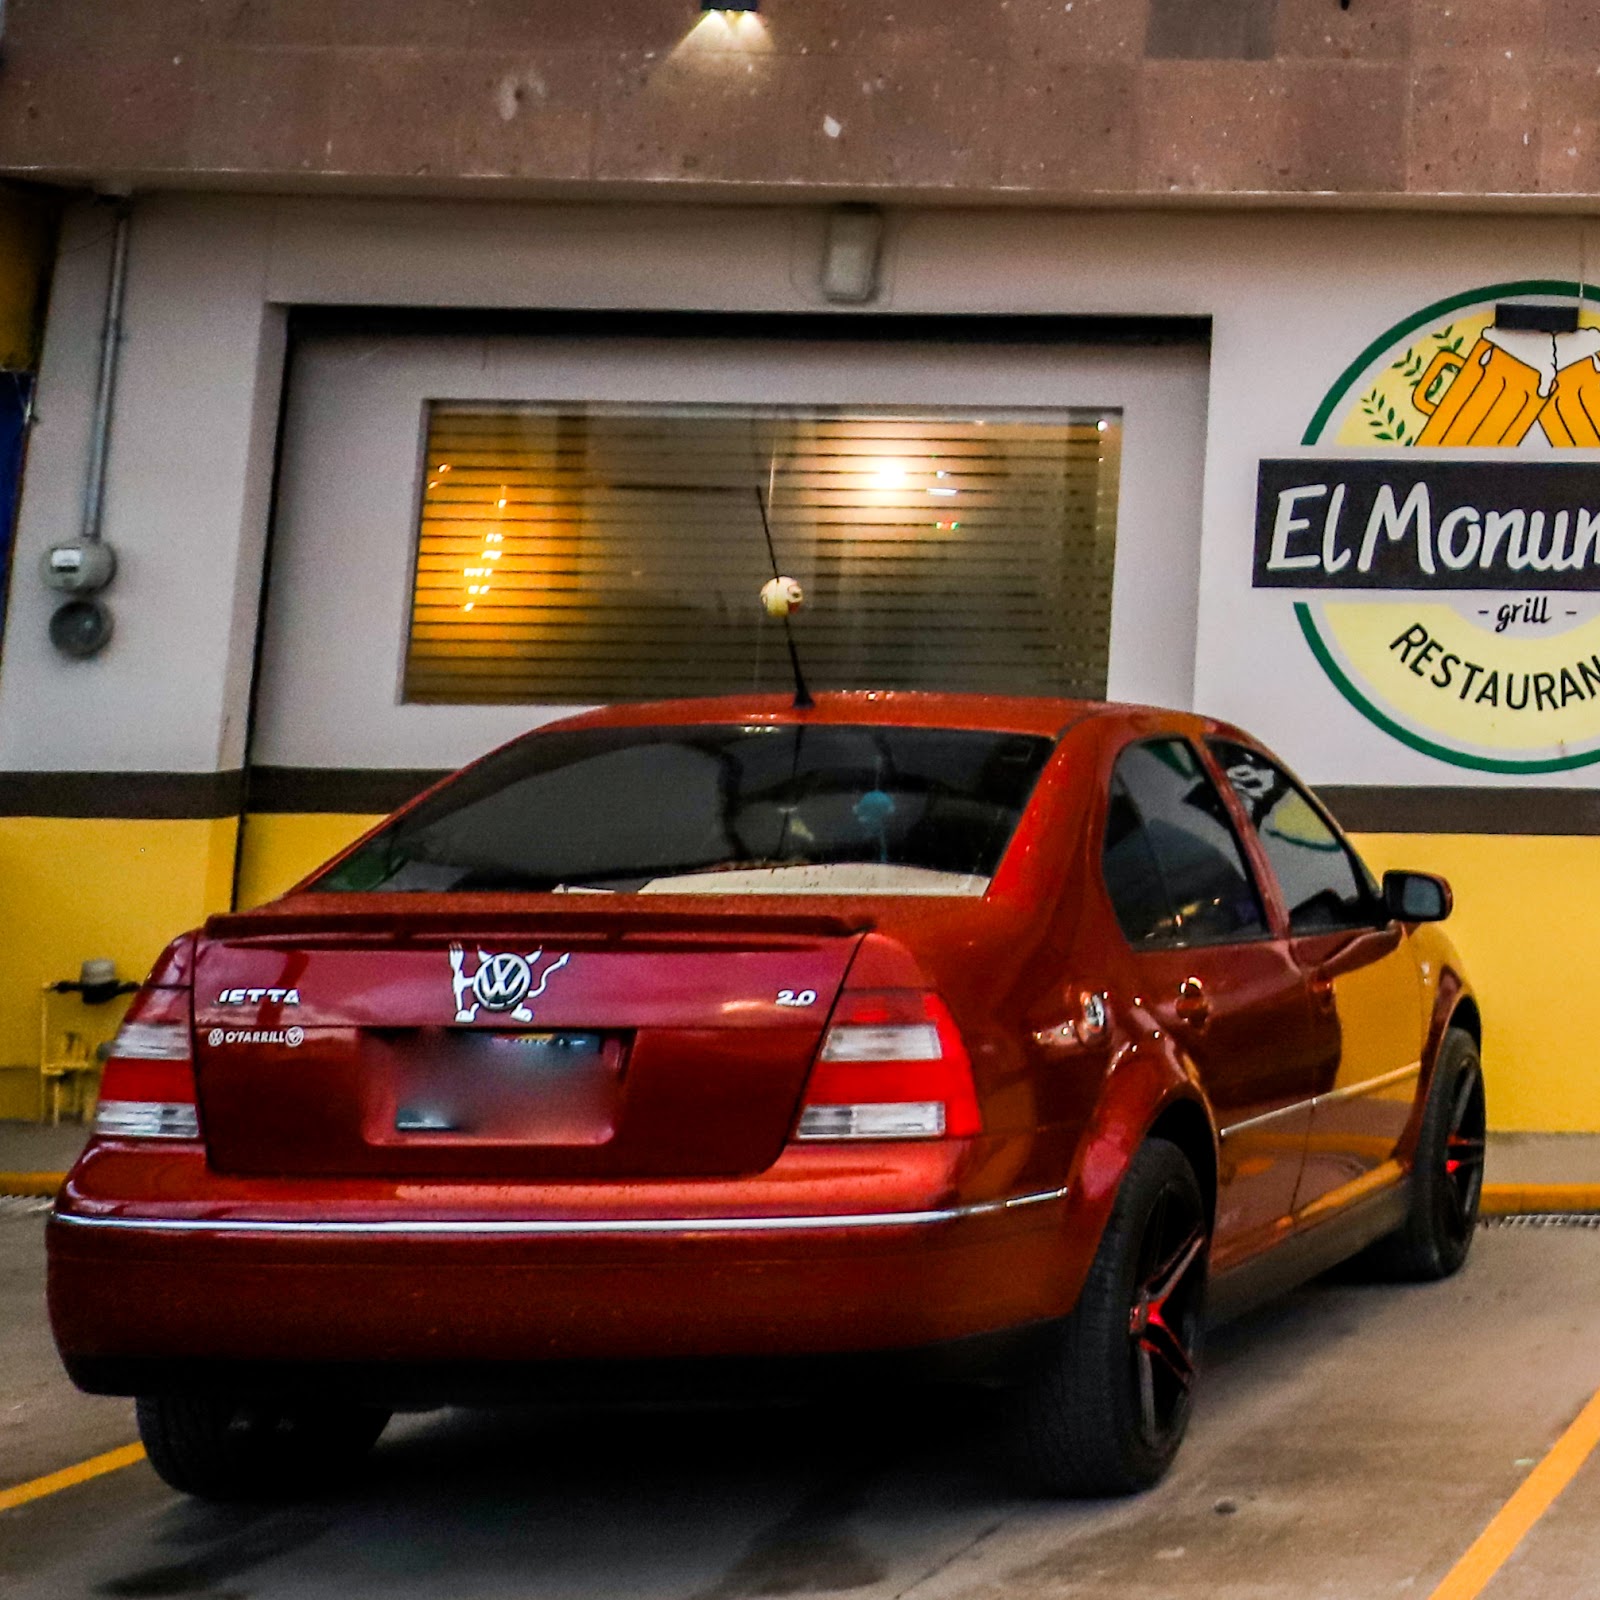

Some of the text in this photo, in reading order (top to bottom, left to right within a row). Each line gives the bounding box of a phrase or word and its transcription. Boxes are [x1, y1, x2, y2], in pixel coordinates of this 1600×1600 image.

[1266, 483, 1350, 574] El
[1494, 597, 1551, 632] grill
[775, 989, 816, 1007] 2.0
